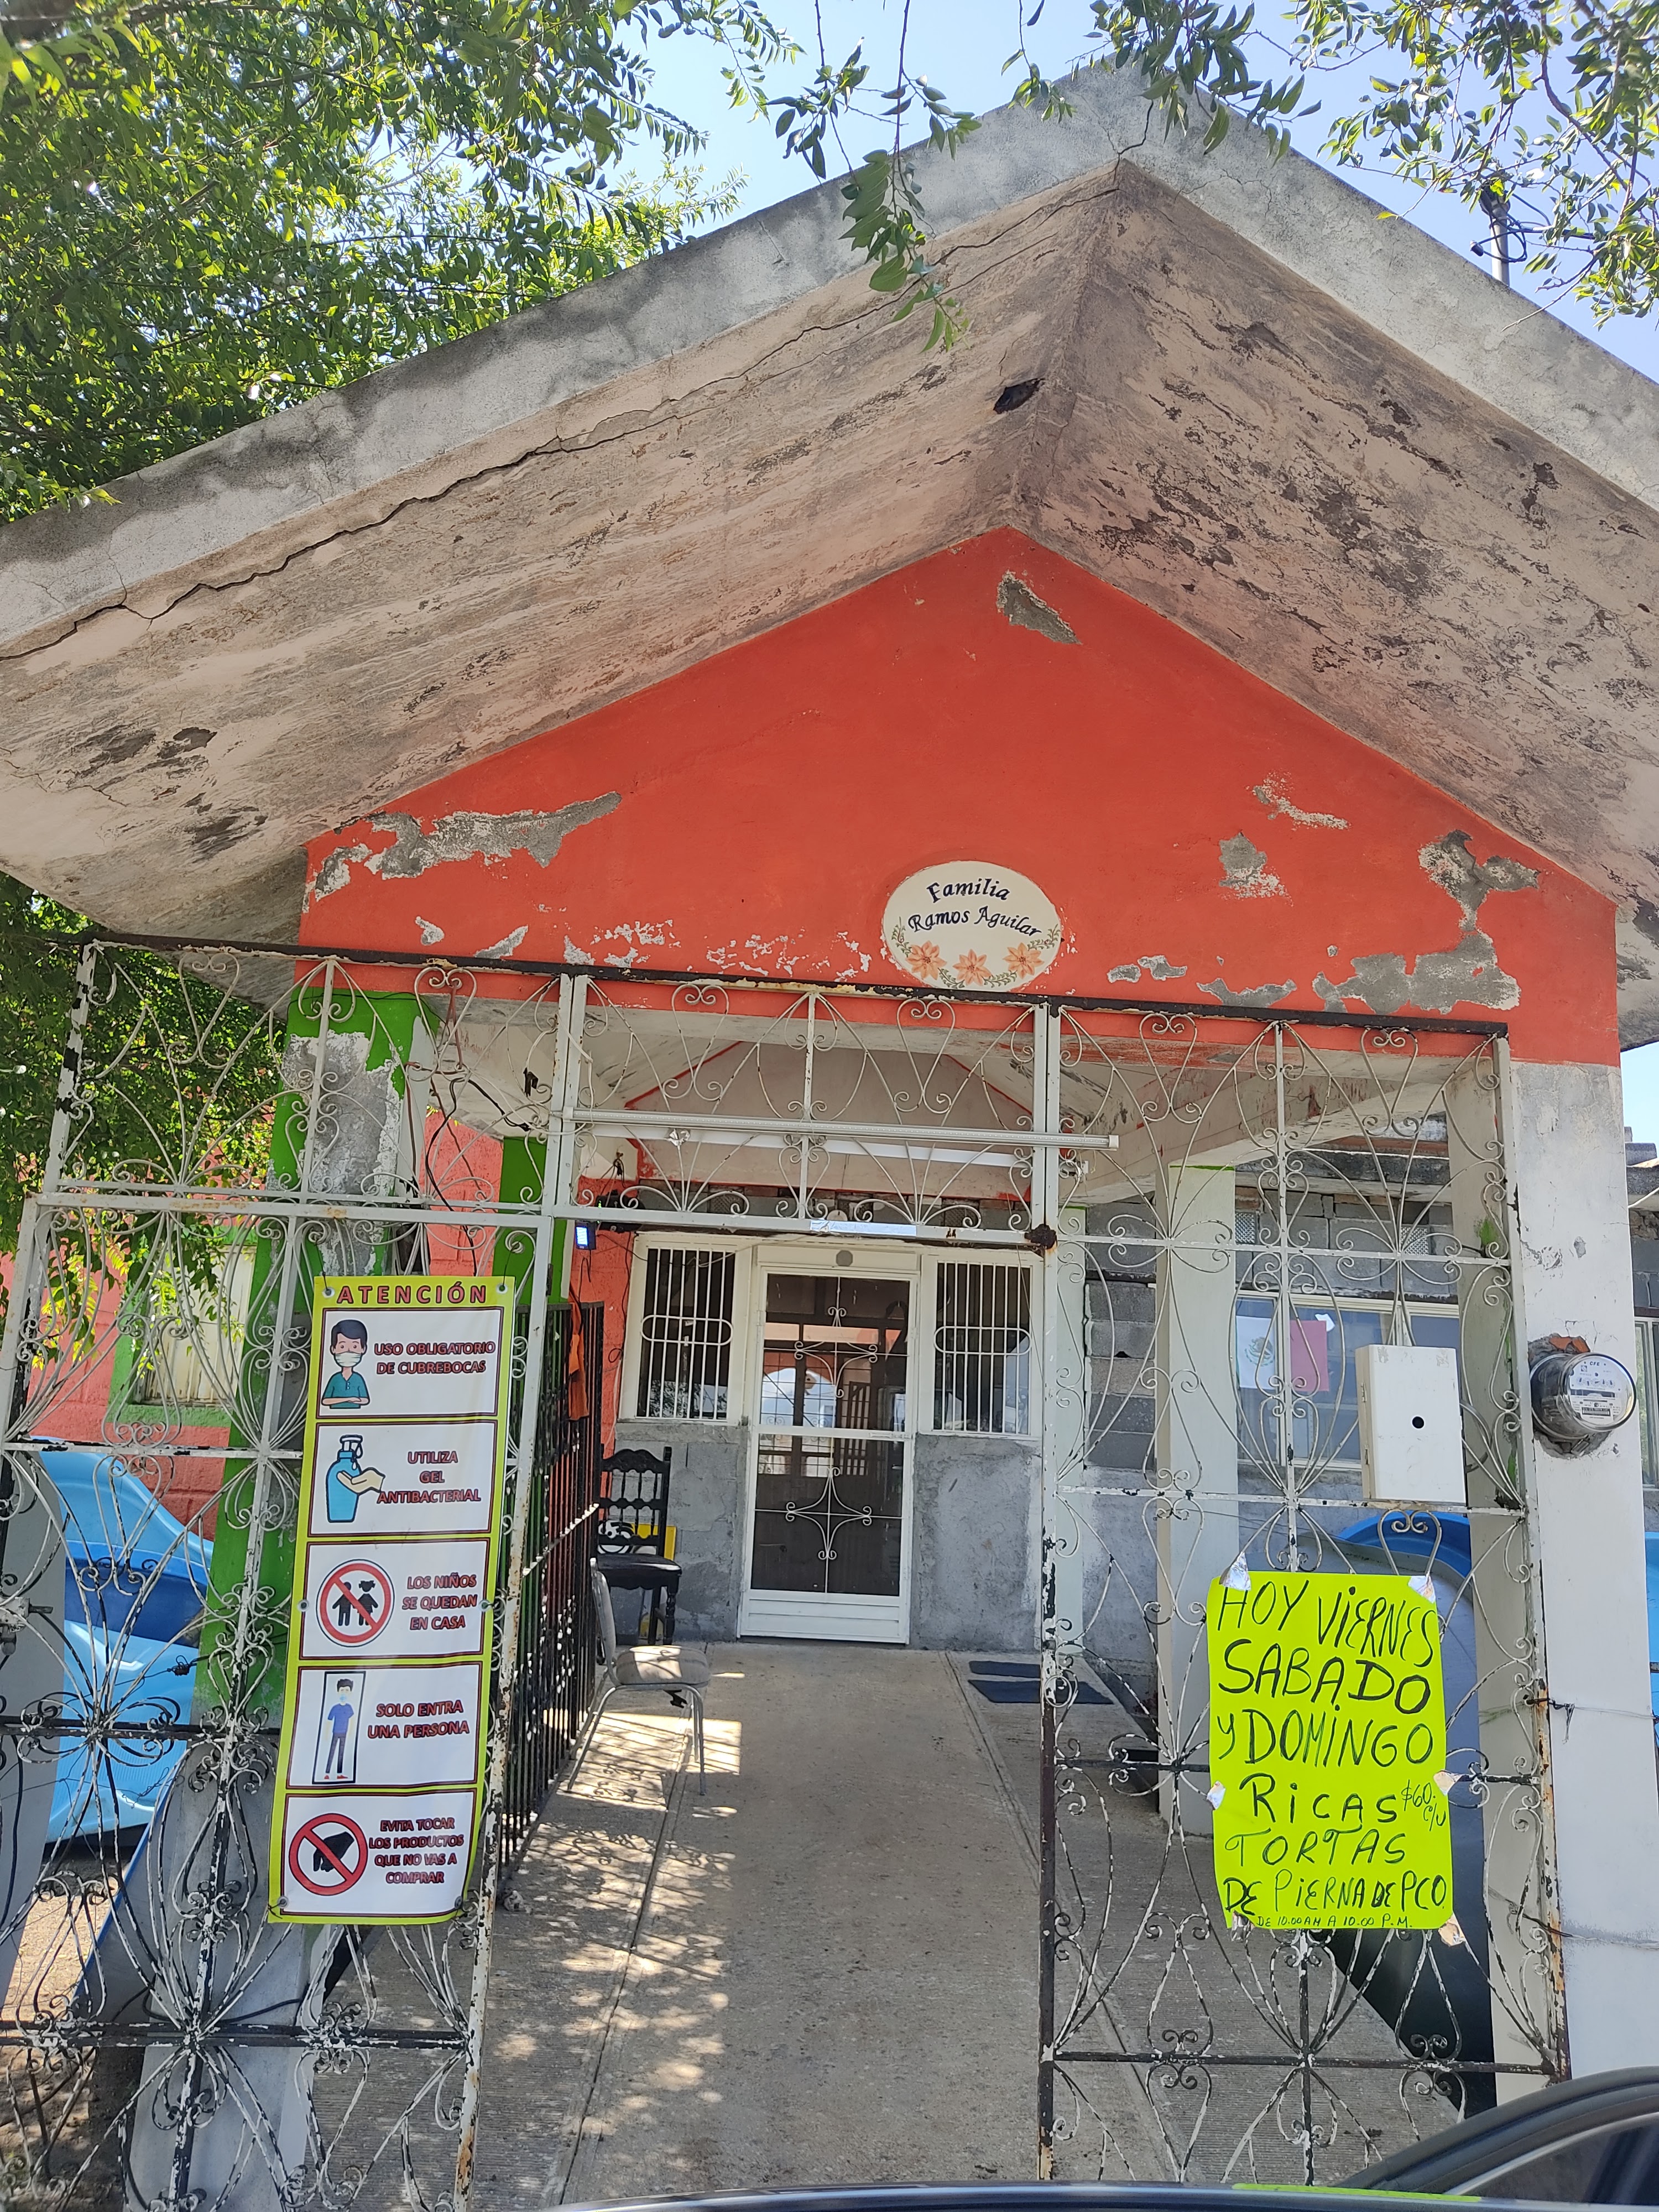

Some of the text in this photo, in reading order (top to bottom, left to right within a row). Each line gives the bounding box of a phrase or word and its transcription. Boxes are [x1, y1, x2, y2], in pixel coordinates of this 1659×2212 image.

[926, 878, 1010, 903] Familia
[908, 905, 1042, 936] Ramos Aguilar
[337, 1281, 487, 1304] ATENCIÓN
[374, 1342, 495, 1355] USO OBLIGATORIO
[377, 1360, 486, 1374] DE CUBREBOCAS
[408, 1452, 458, 1464] UTILIZA
[420, 1472, 445, 1484] GEL
[377, 1490, 481, 1504] ANTIBACTERIAL
[408, 1573, 476, 1589] LOS NIÑOS
[402, 1594, 477, 1611] SE QUEDAN
[1218, 1579, 1310, 1631] HOY
[410, 1616, 466, 1630] EN CASA
[1218, 1638, 1431, 1714] SABADO
[377, 1700, 463, 1717] SOLO ENTRA
[368, 1720, 469, 1739] UNA PERSONA
[380, 1818, 455, 1832] EVITA TOCAR
[369, 1835, 464, 1849] LOS PRODUCTOS
[1224, 1824, 1406, 1867] TORTAS
[374, 1854, 457, 1867] QUE NO VAS A
[385, 1872, 444, 1884] COMPRAR
[1223, 1877, 1262, 1916] DE
[1256, 1916, 1271, 1927] DE
[1327, 1915, 1336, 1927] A
[1344, 1916, 1374, 1927] 10.00
